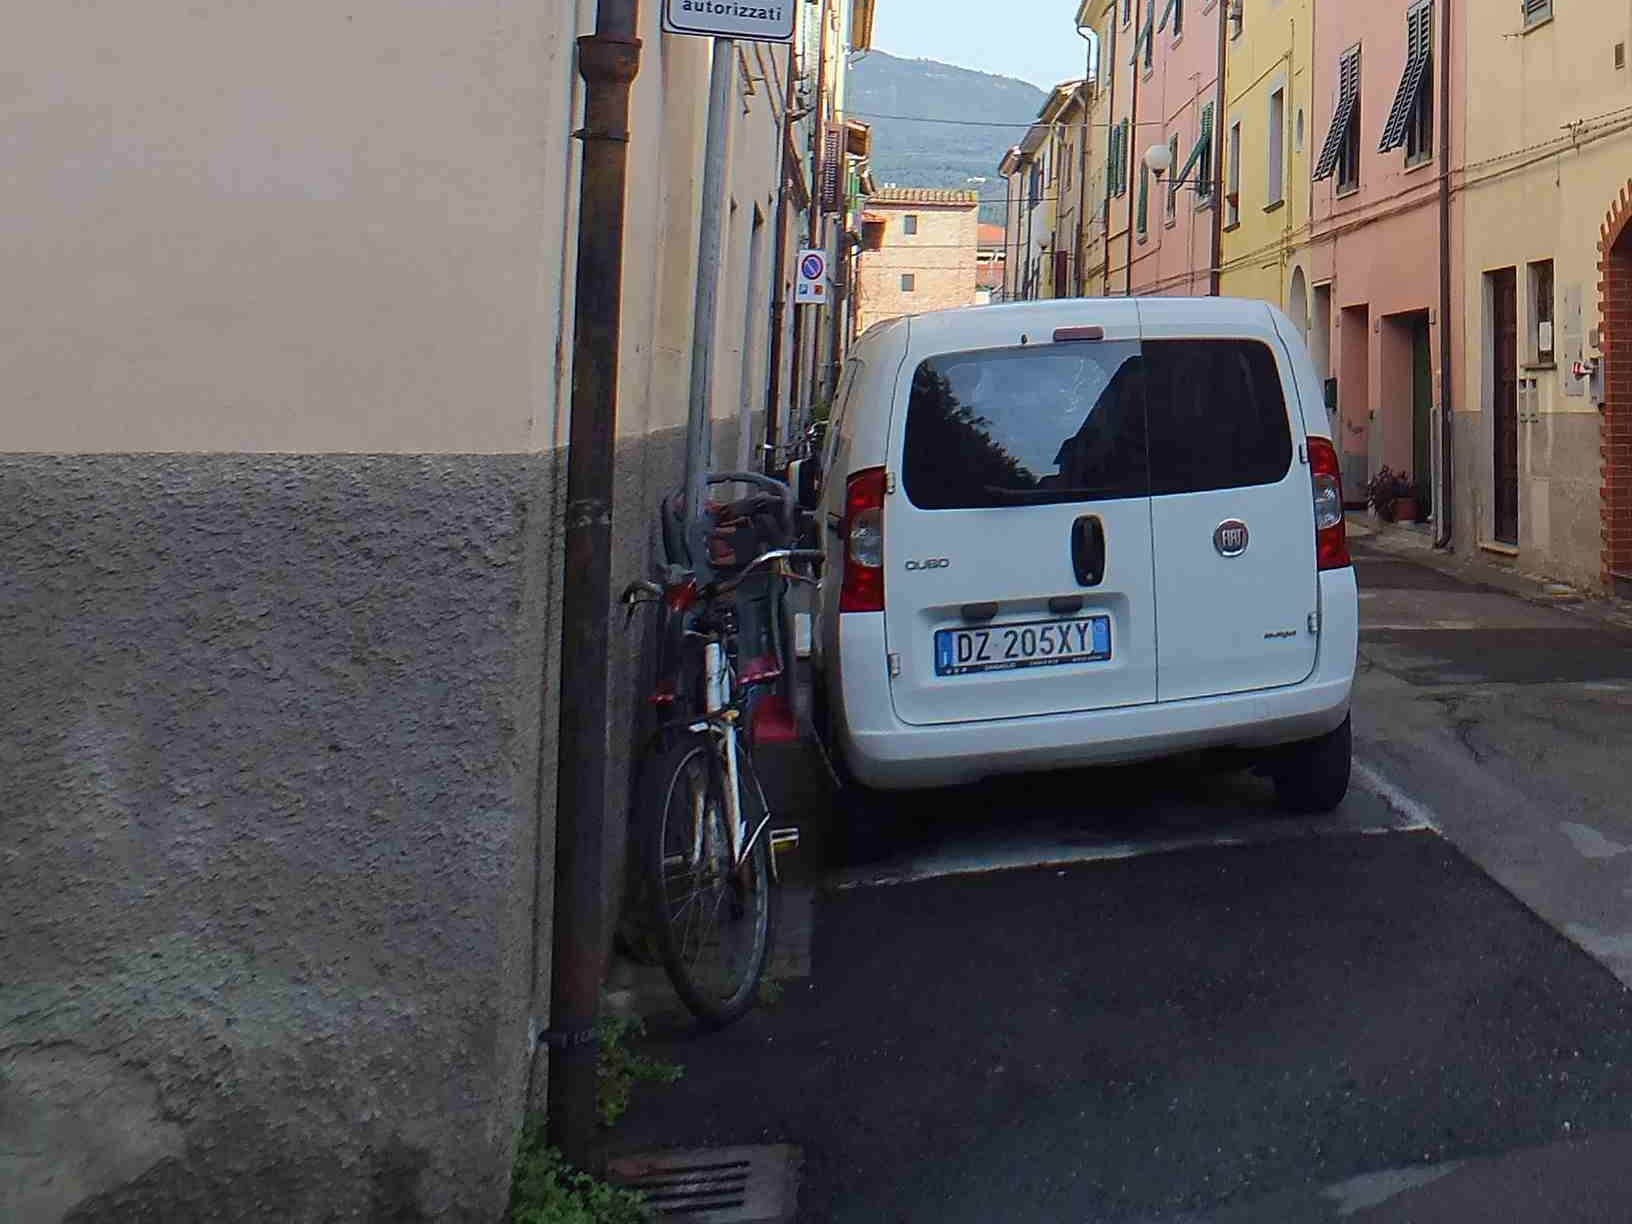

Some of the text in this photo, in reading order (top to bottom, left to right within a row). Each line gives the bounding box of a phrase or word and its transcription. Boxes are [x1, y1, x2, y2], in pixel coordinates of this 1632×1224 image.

[682, 0, 782, 22] autorizzati
[904, 558, 951, 570] QUBO
[957, 622, 1090, 664] DZ 205XY
